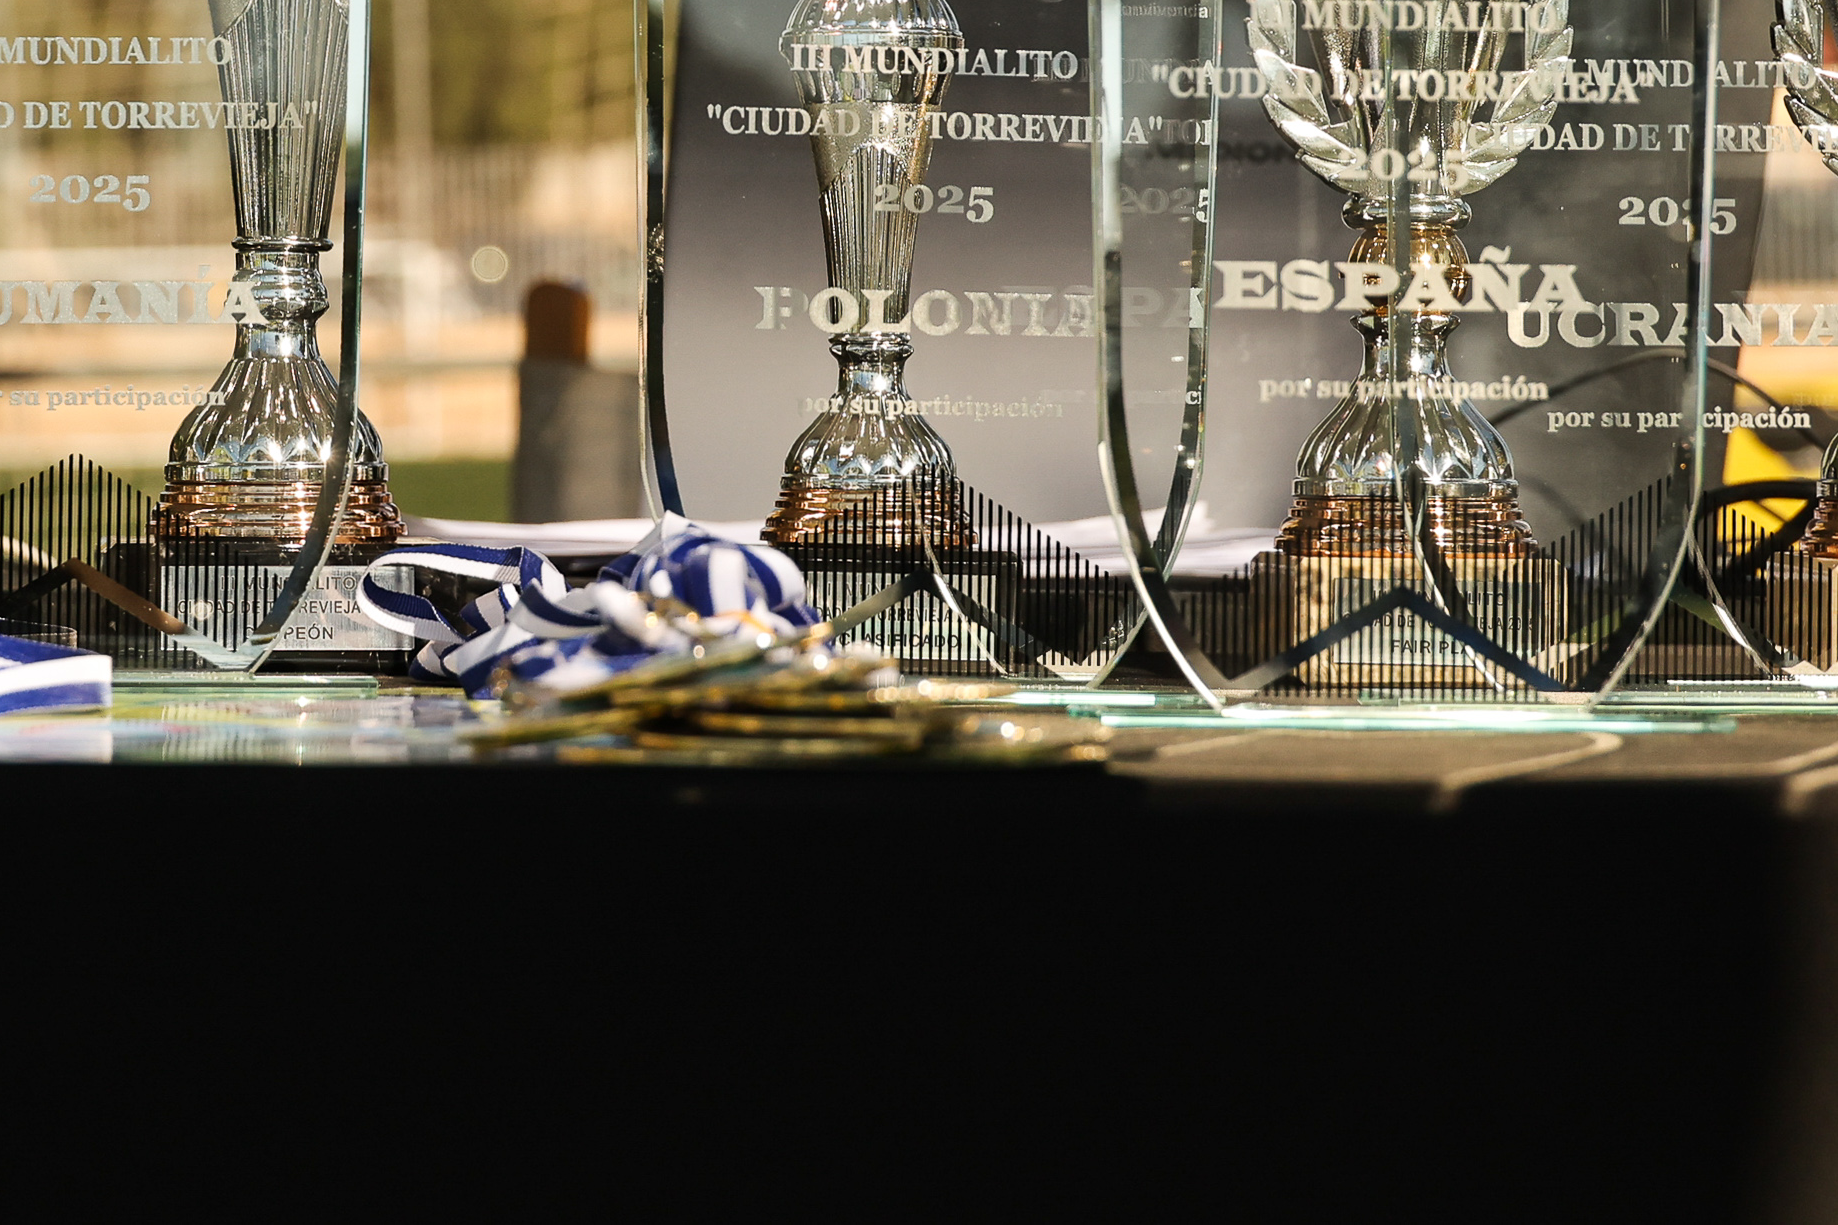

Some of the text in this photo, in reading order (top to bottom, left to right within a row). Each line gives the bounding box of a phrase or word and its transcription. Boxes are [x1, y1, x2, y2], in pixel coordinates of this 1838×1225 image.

[790, 43, 832, 72] III
[842, 44, 1078, 79] MUNDIALITO
[1585, 58, 1816, 89] MUNDALITO
[1150, 64, 1322, 100] "CIUDAD
[1332, 66, 1389, 101] DE
[23, 101, 72, 130] DE
[77, 99, 318, 130] TORREVIEJA"
[706, 102, 861, 136] "CIUDAD
[870, 107, 924, 138] DE
[927, 109, 1163, 145] TORREVIEA"
[1612, 124, 1661, 152] DE
[1340, 148, 1470, 190] 2025
[29, 174, 152, 212] 2025
[874, 184, 995, 224] 2025
[1213, 245, 1596, 314] ESPAÑA
[753, 286, 1098, 337] POLONIA
[1506, 302, 1838, 348] UCRANIA
[9, 390, 42, 407] su
[46, 384, 227, 411] participación
[1259, 375, 1549, 403] por su participación
[850, 398, 882, 415] su
[888, 394, 1063, 422] participación
[1546, 406, 1811, 434] por su parcipación
[246, 576, 357, 590] MUNLITO
[177, 600, 361, 614] CIDAD DE TREVIEJA
[873, 607, 951, 623] ORREVIEJA
[1398, 614, 1414, 628] DE
[246, 622, 334, 640] CPEÓN
[839, 633, 960, 649] CASIFICADO
[1392, 640, 1468, 655] FAIR PLA
